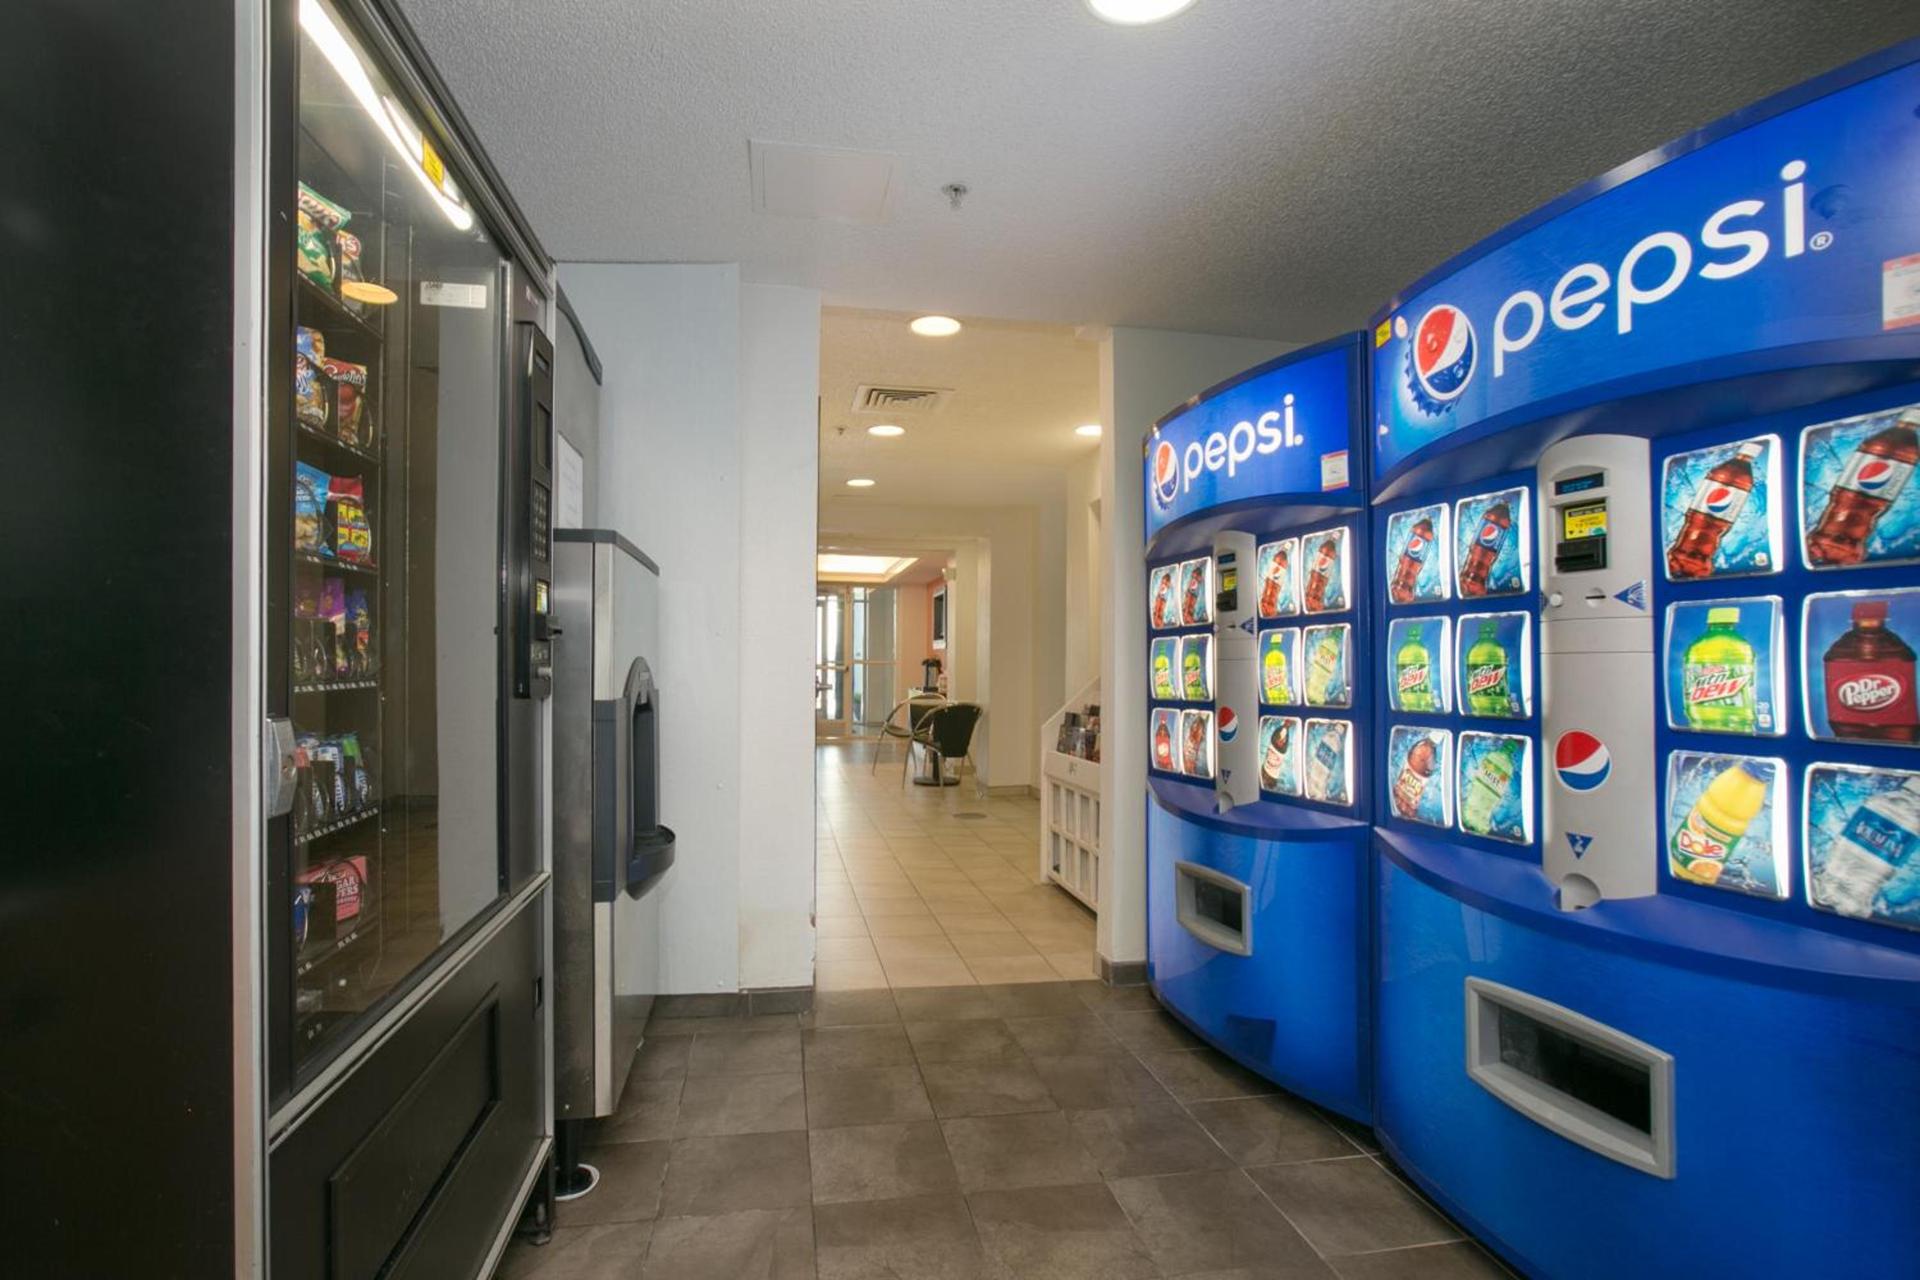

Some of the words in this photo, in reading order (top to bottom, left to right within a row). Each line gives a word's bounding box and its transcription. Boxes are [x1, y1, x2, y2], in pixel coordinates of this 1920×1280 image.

[1494, 159, 1806, 379] pepsi
[1184, 393, 1296, 494] pepsi
[1845, 681, 1896, 706] Pepper
[1859, 679, 1881, 695] Dr
[1680, 831, 1723, 856] Dole
